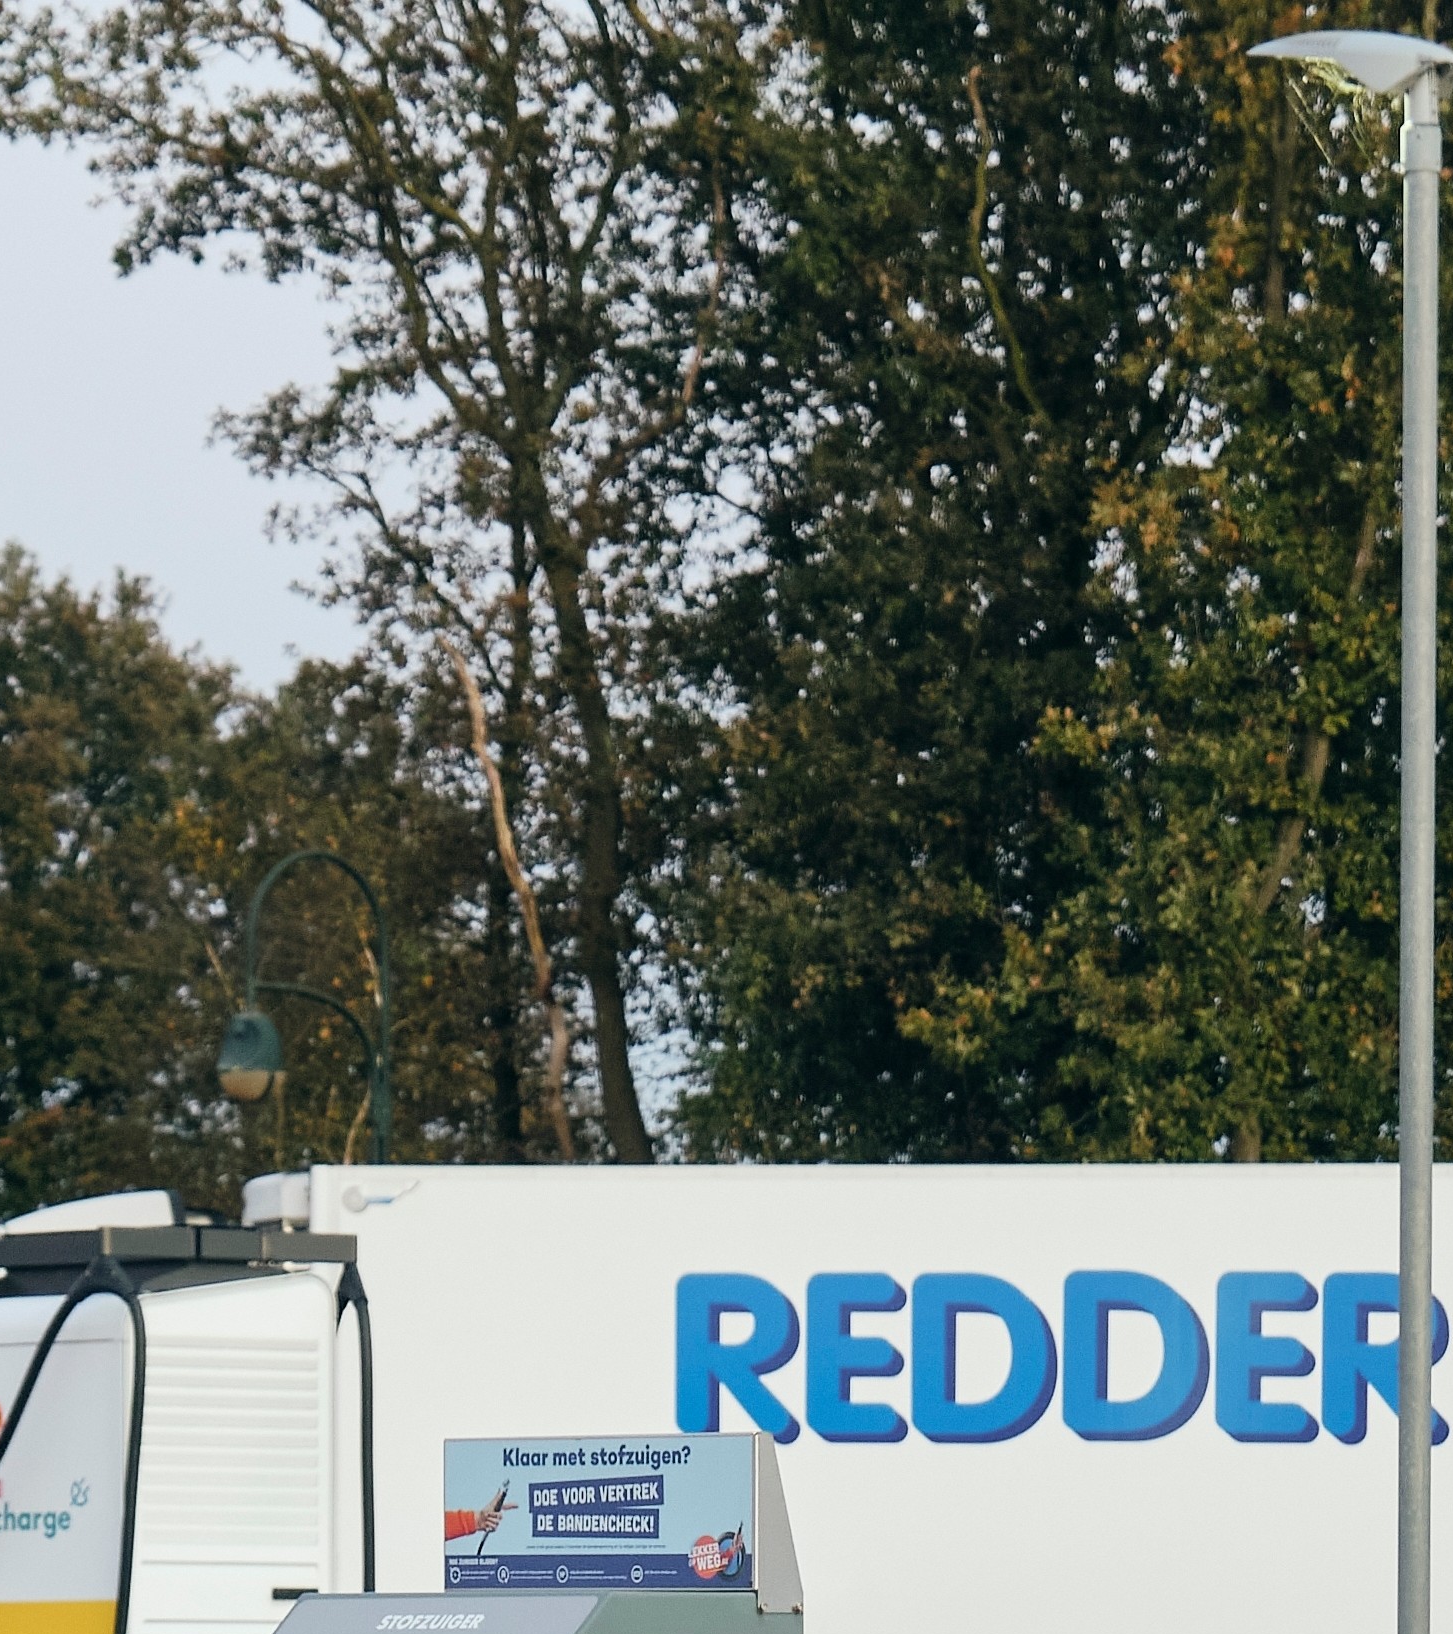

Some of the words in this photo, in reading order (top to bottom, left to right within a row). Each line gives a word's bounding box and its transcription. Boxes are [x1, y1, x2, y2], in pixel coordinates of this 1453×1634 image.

[676, 1271, 1449, 1445] REDDER
[502, 1447, 549, 1467] Klaar
[552, 1447, 586, 1467] met
[590, 1444, 691, 1470] stofzuigen?
[532, 1487, 559, 1507] DOE
[561, 1485, 596, 1506] VOOR
[598, 1481, 660, 1503] VERTREK
[536, 1513, 554, 1532] DE
[557, 1513, 655, 1533] BANDENCHECK!
[375, 1614, 486, 1631] STOFZUIGER
